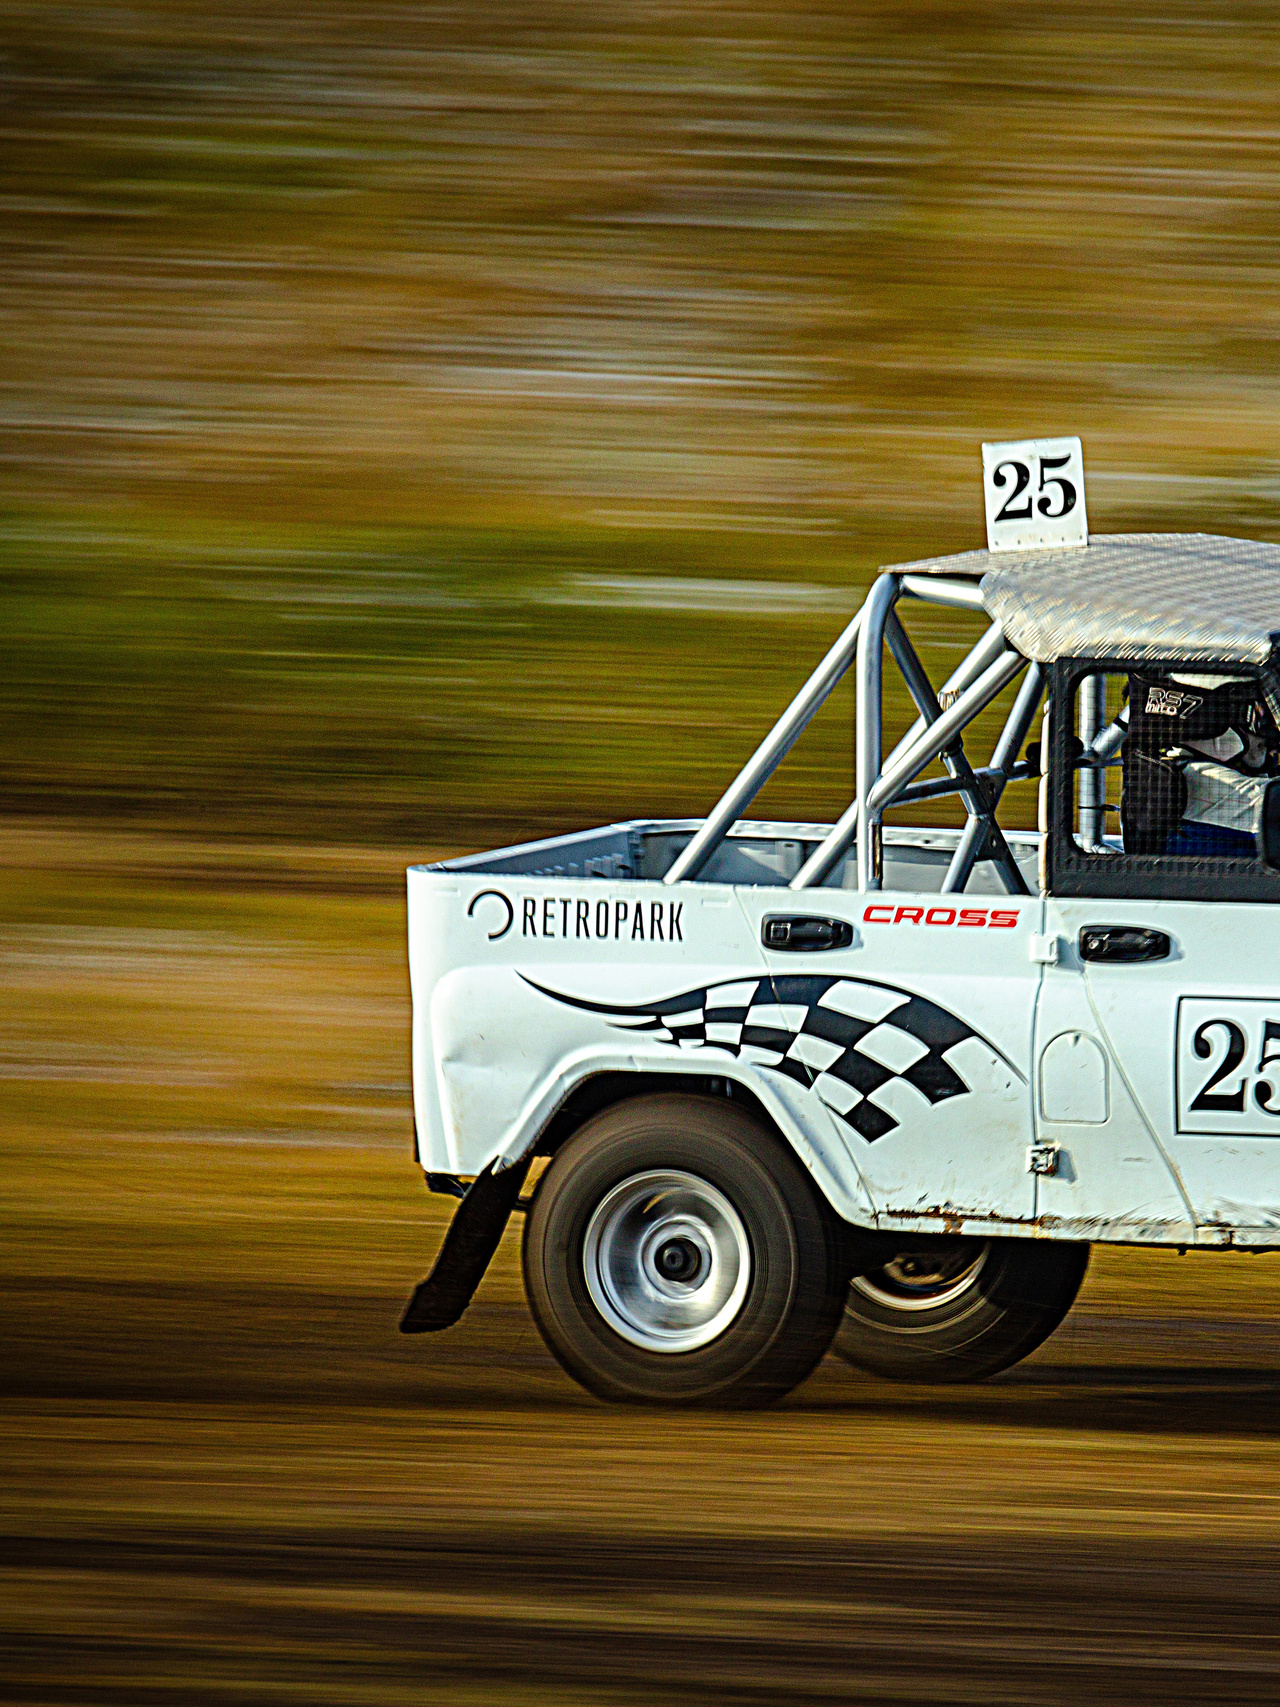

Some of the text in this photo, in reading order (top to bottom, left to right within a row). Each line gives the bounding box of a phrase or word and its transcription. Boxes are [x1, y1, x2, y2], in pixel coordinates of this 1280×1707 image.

[992, 453, 1077, 523] 25
[522, 896, 684, 942] RETROPARK
[863, 904, 1021, 929] CROSS
